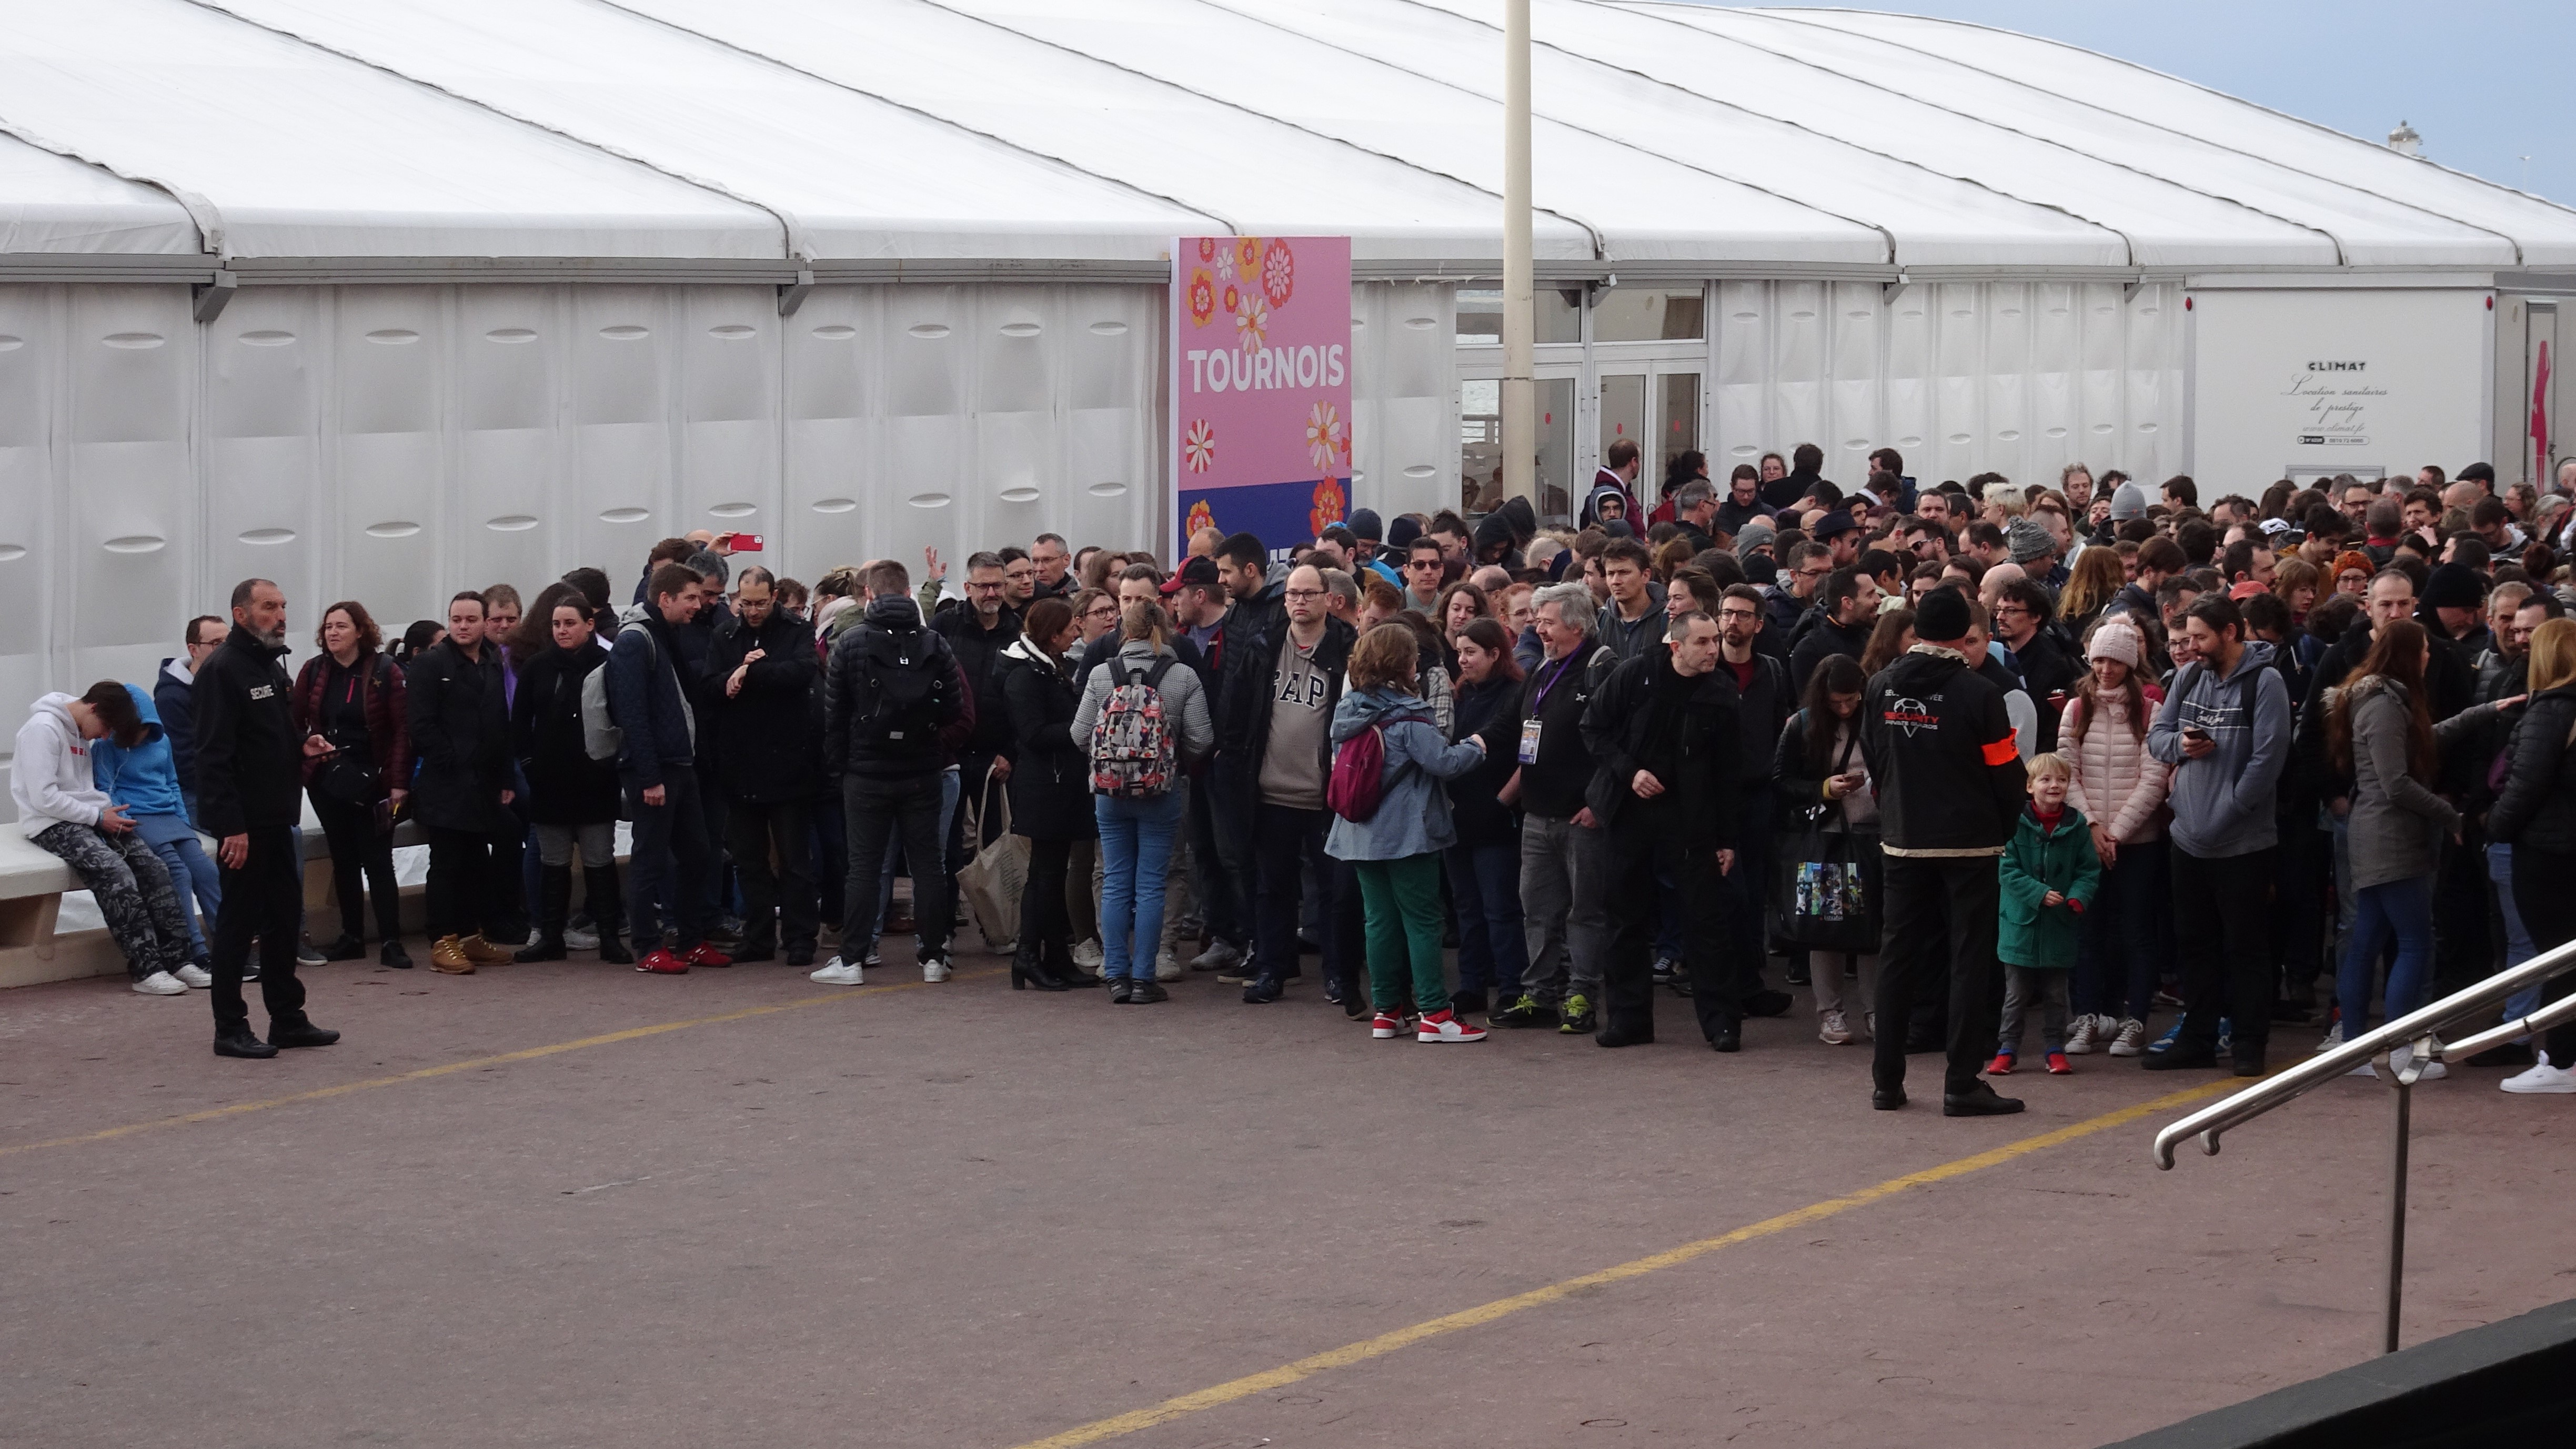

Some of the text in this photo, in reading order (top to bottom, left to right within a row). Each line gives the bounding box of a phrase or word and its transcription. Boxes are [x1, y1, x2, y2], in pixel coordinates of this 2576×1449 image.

[1188, 345, 1344, 393] TOURNOIS
[2308, 361, 2366, 371] CLIMAT
[2280, 374, 2388, 396] Location sanitaires
[2310, 397, 2364, 424] de prestige
[1884, 712, 1939, 723] SECURITY
